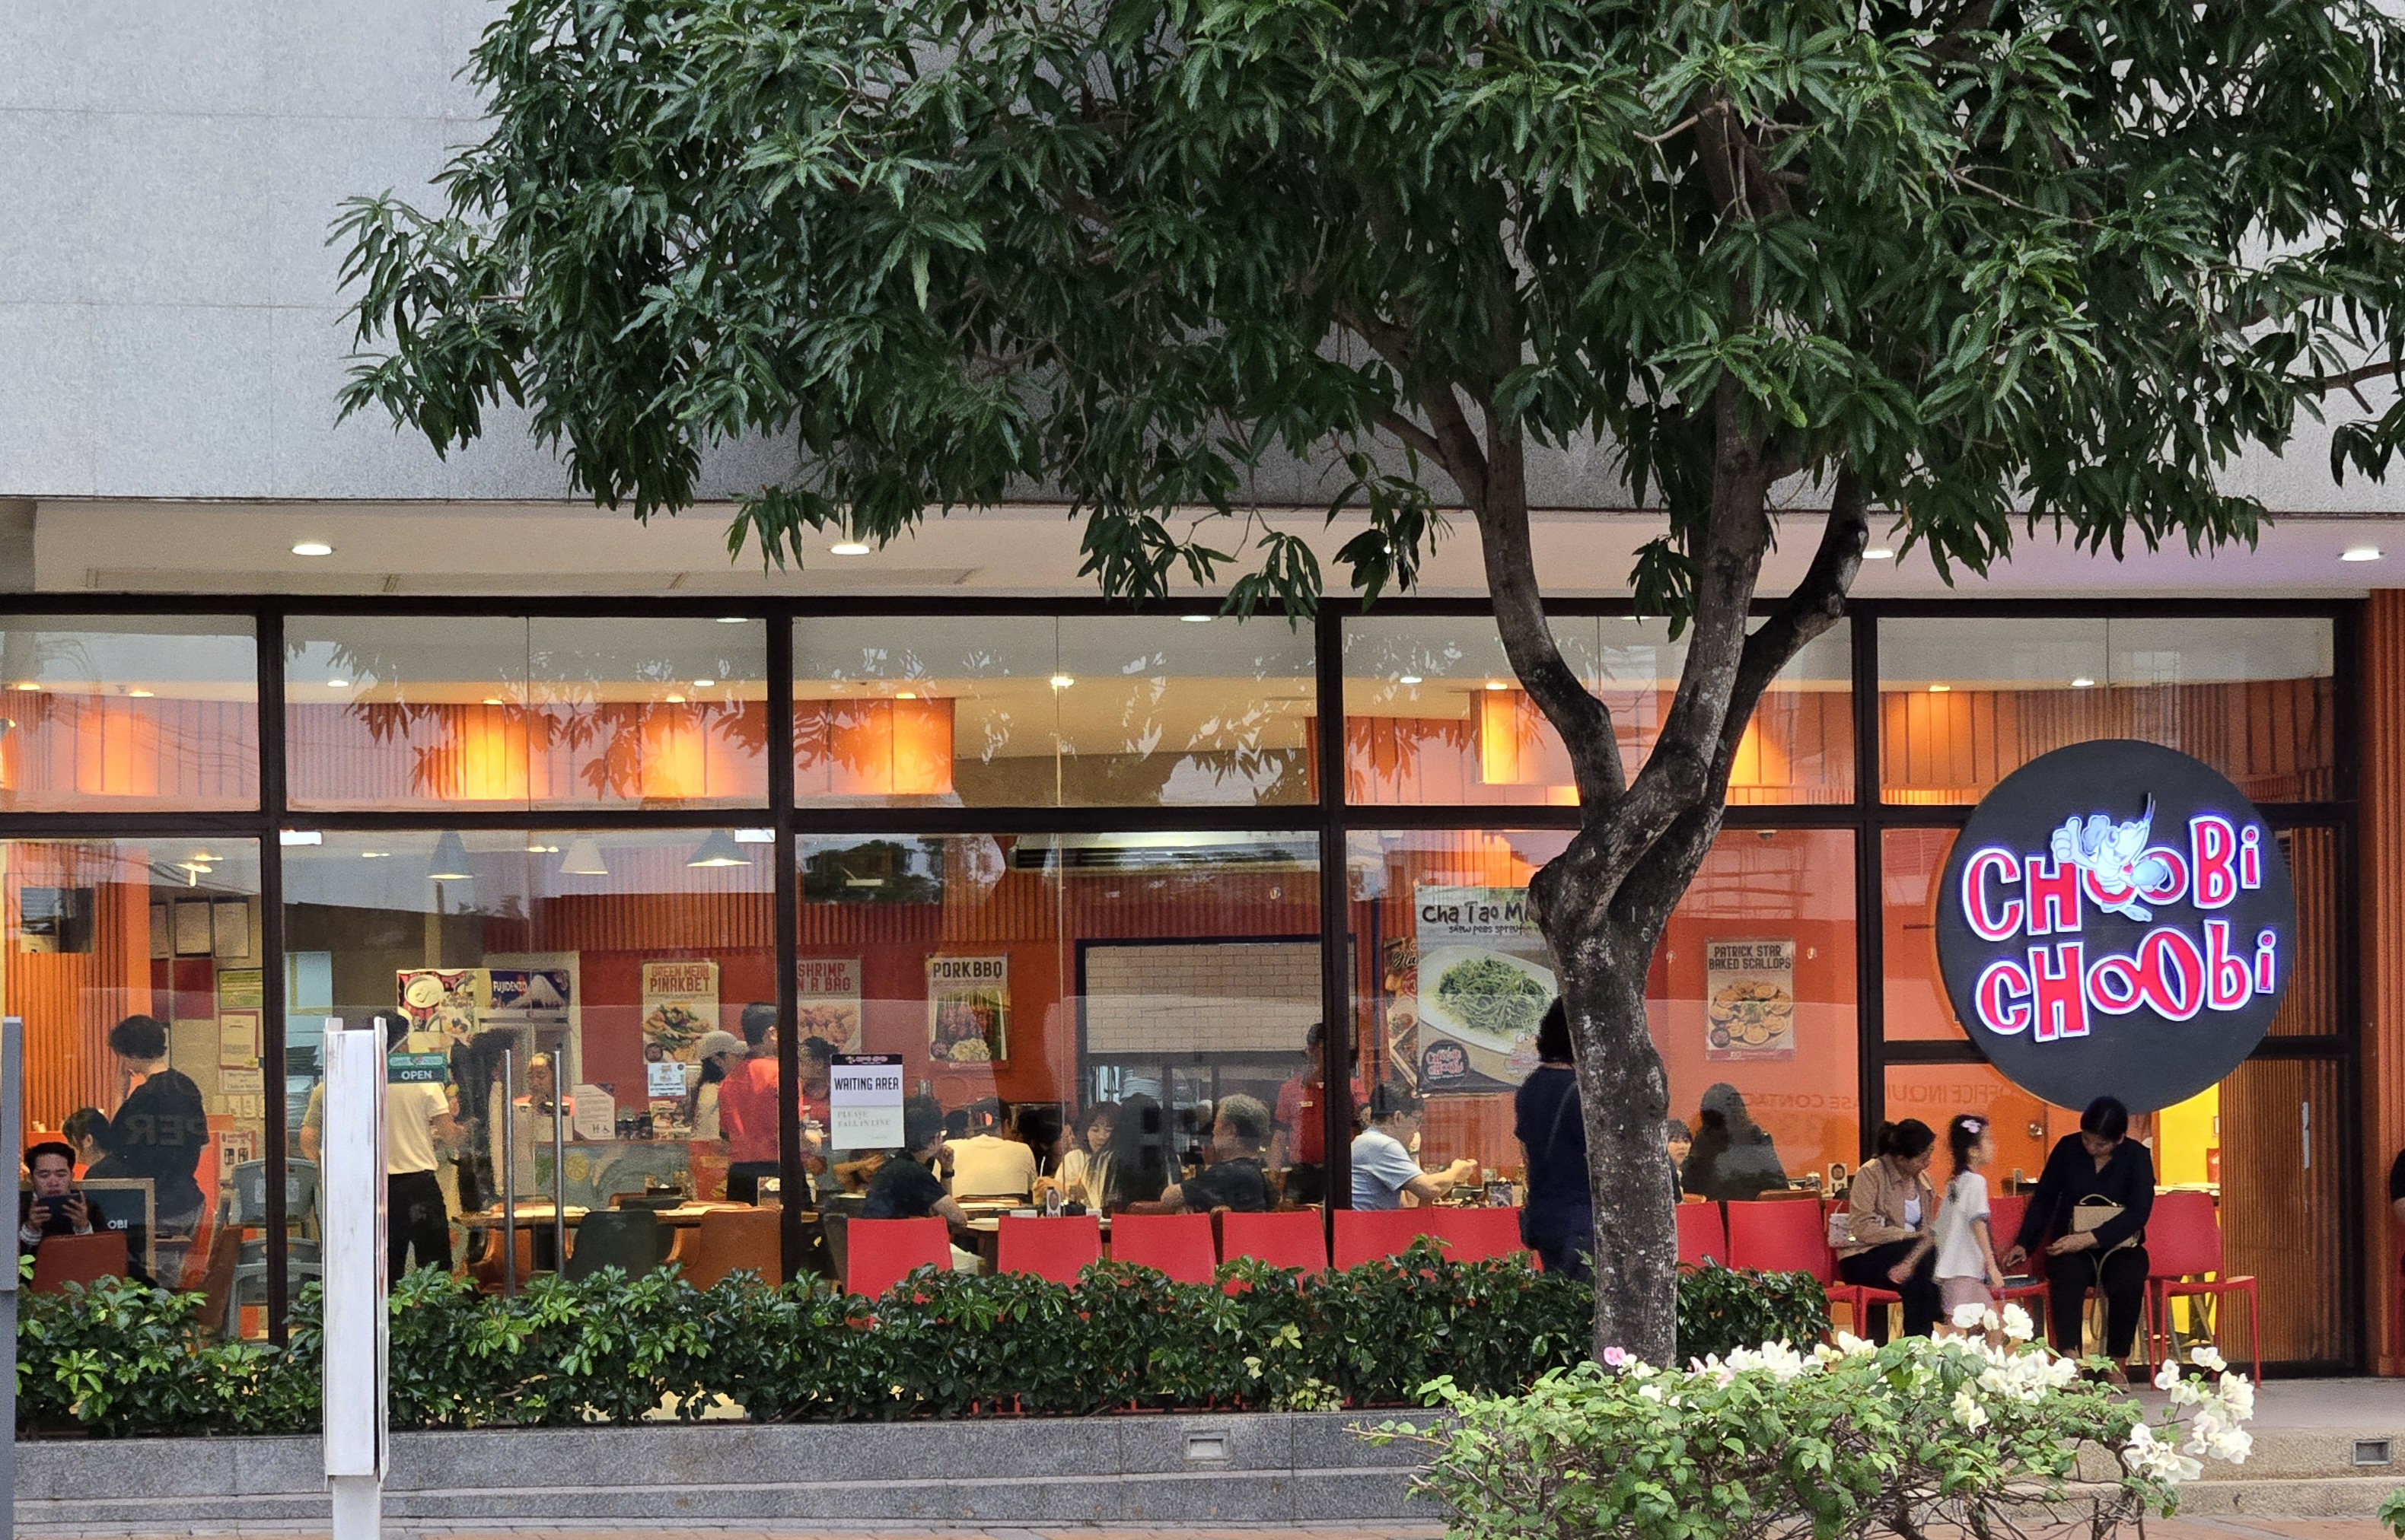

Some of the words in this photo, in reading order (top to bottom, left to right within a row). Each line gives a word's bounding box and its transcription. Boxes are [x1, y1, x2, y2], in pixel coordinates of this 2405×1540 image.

[1422, 904, 1460, 924] Cha
[1464, 900, 1499, 924] Tao
[1714, 945, 1753, 958] PATRICK
[1757, 945, 1782, 957] STAR
[798, 962, 845, 978] SHRIMP
[933, 962, 971, 978] PORK
[973, 961, 1002, 979] BBQ
[1709, 958, 1739, 970] BAKED
[1743, 957, 1791, 970] SCALLOPS
[492, 980, 528, 993] FUJIDENZO
[649, 977, 710, 993] PINAKBET
[824, 977, 852, 991] BAG
[401, 1070, 432, 1080] OPEN
[834, 1077, 873, 1091] WAITING
[875, 1077, 899, 1090] AREA
